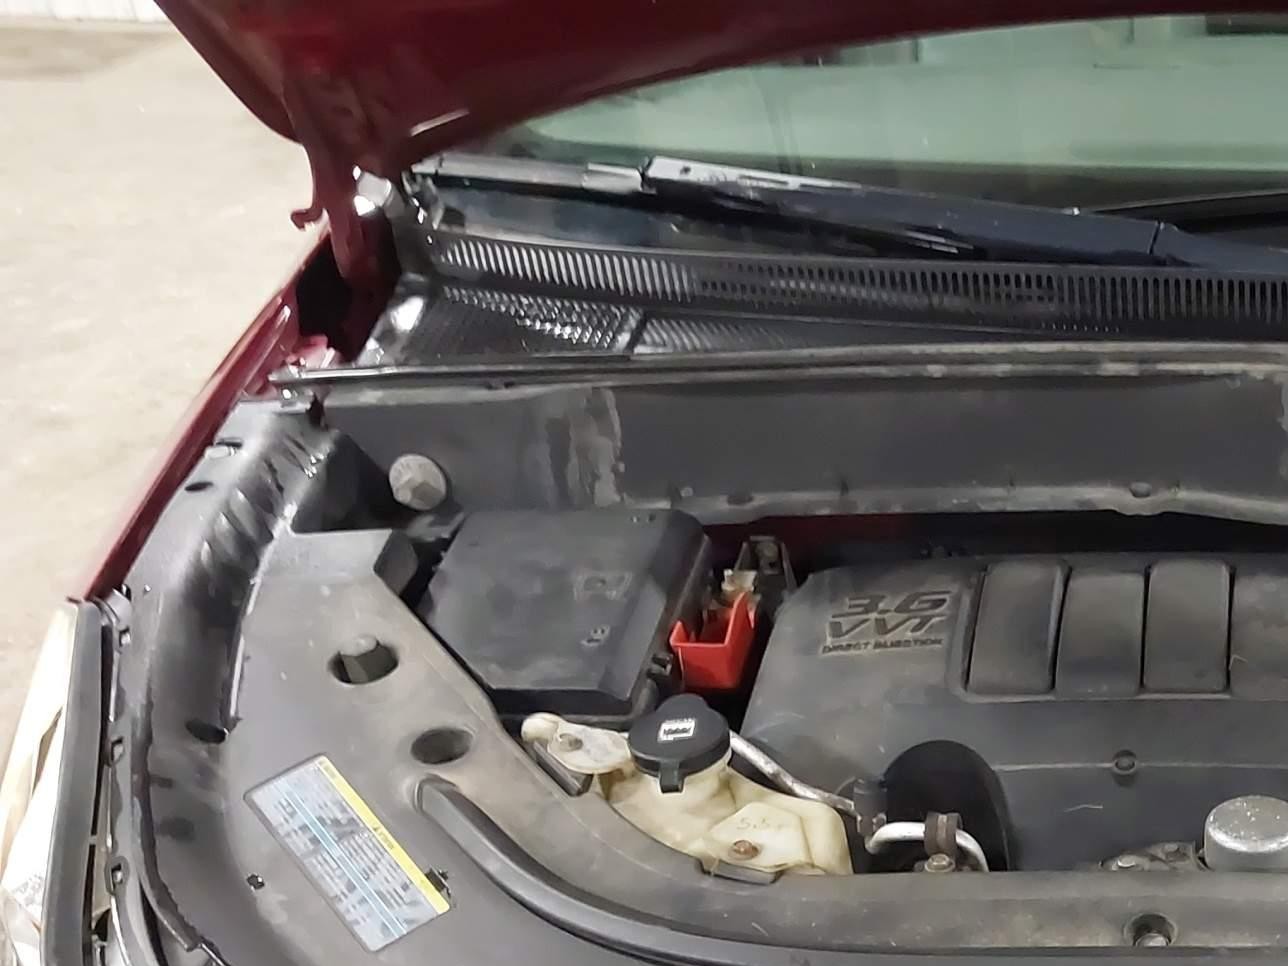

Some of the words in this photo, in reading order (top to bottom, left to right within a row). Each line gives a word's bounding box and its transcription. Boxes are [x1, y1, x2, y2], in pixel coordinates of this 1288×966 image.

[832, 590, 952, 618] 3.6
[826, 614, 947, 639] VVT
[821, 642, 870, 654] DIRECT
[873, 638, 943, 650] INJECTION
